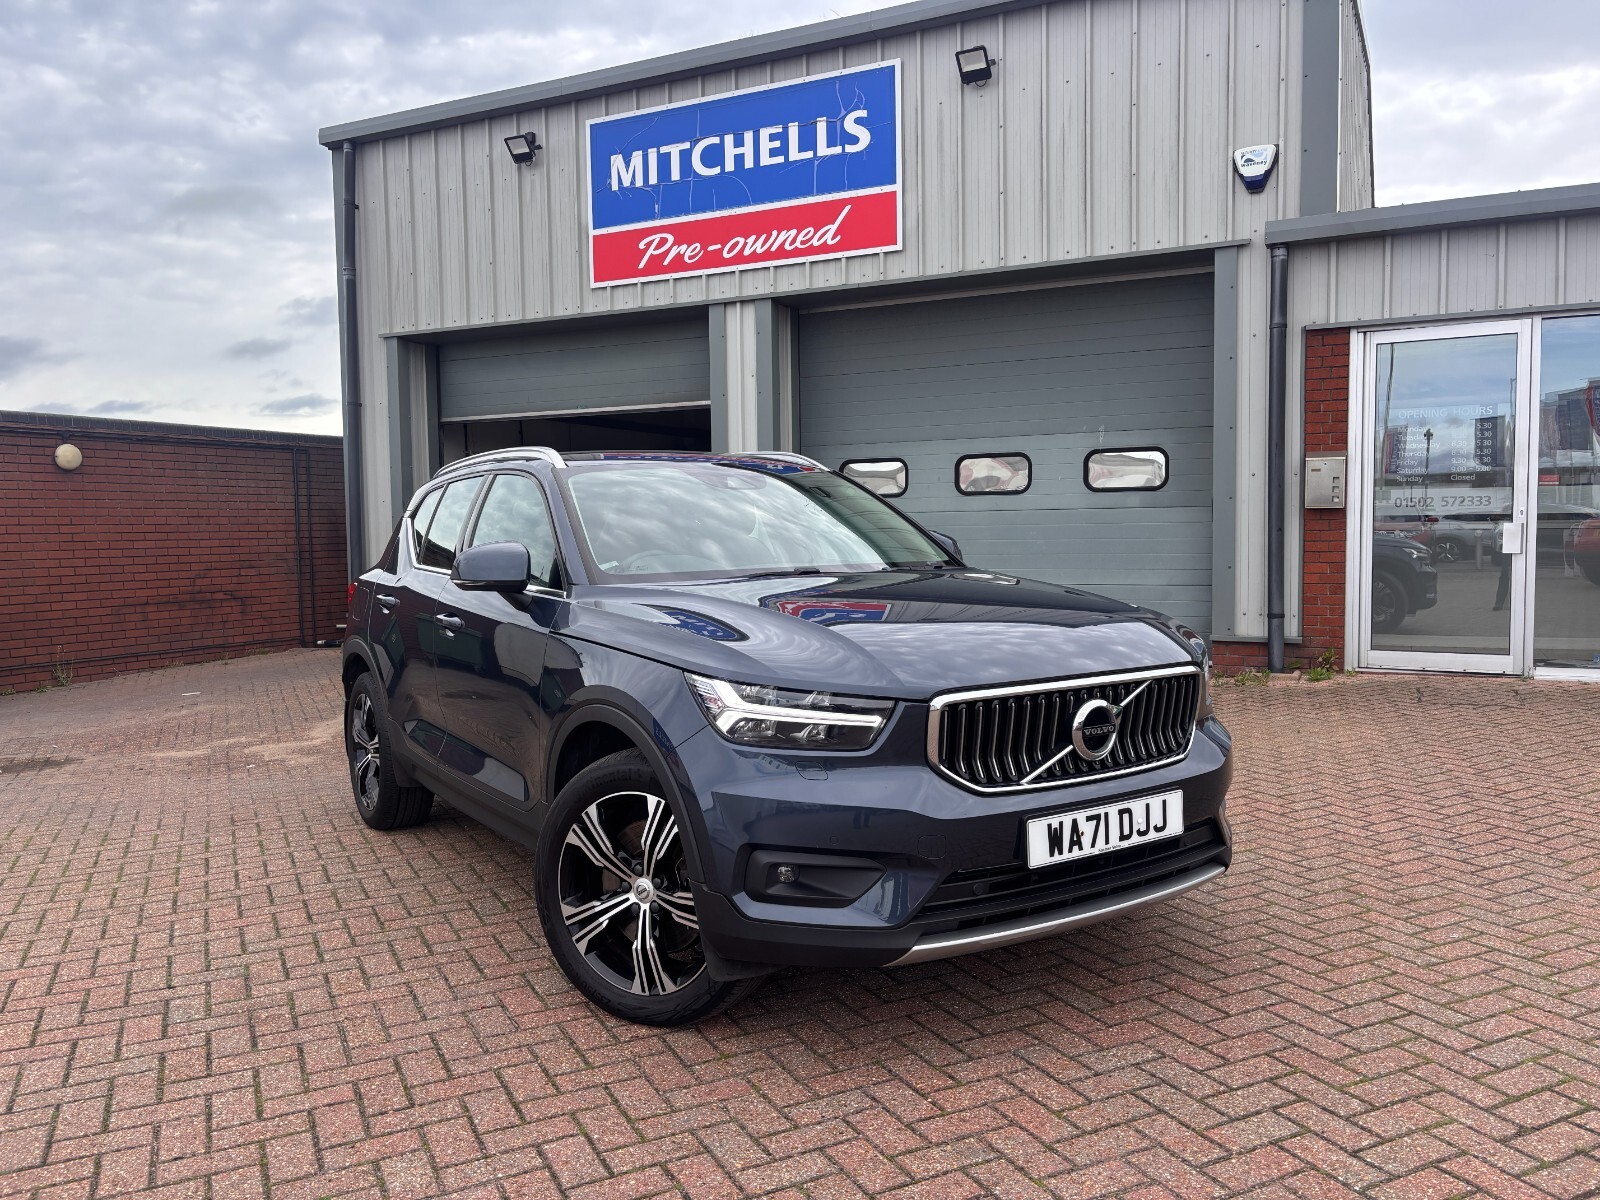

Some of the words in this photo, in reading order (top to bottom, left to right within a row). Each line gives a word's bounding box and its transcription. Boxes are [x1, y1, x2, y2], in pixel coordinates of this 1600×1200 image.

[610, 110, 871, 191] MITCHELLS
[638, 205, 852, 269] Pre-owned
[1398, 408, 1448, 419] OPENING
[1453, 405, 1493, 416] HOURS
[1397, 450, 1430, 458] Thursday
[1396, 458, 1419, 466] Friday
[1396, 467, 1428, 475] Saturday
[1396, 475, 1424, 483] Sunday
[1450, 473, 1476, 481] Closed
[1394, 496, 1435, 508] 01502
[1441, 495, 1492, 508] 572333
[1083, 725, 1115, 736] VOLVO
[1047, 811, 1109, 858] WA71
[1118, 799, 1167, 842] DJJ
